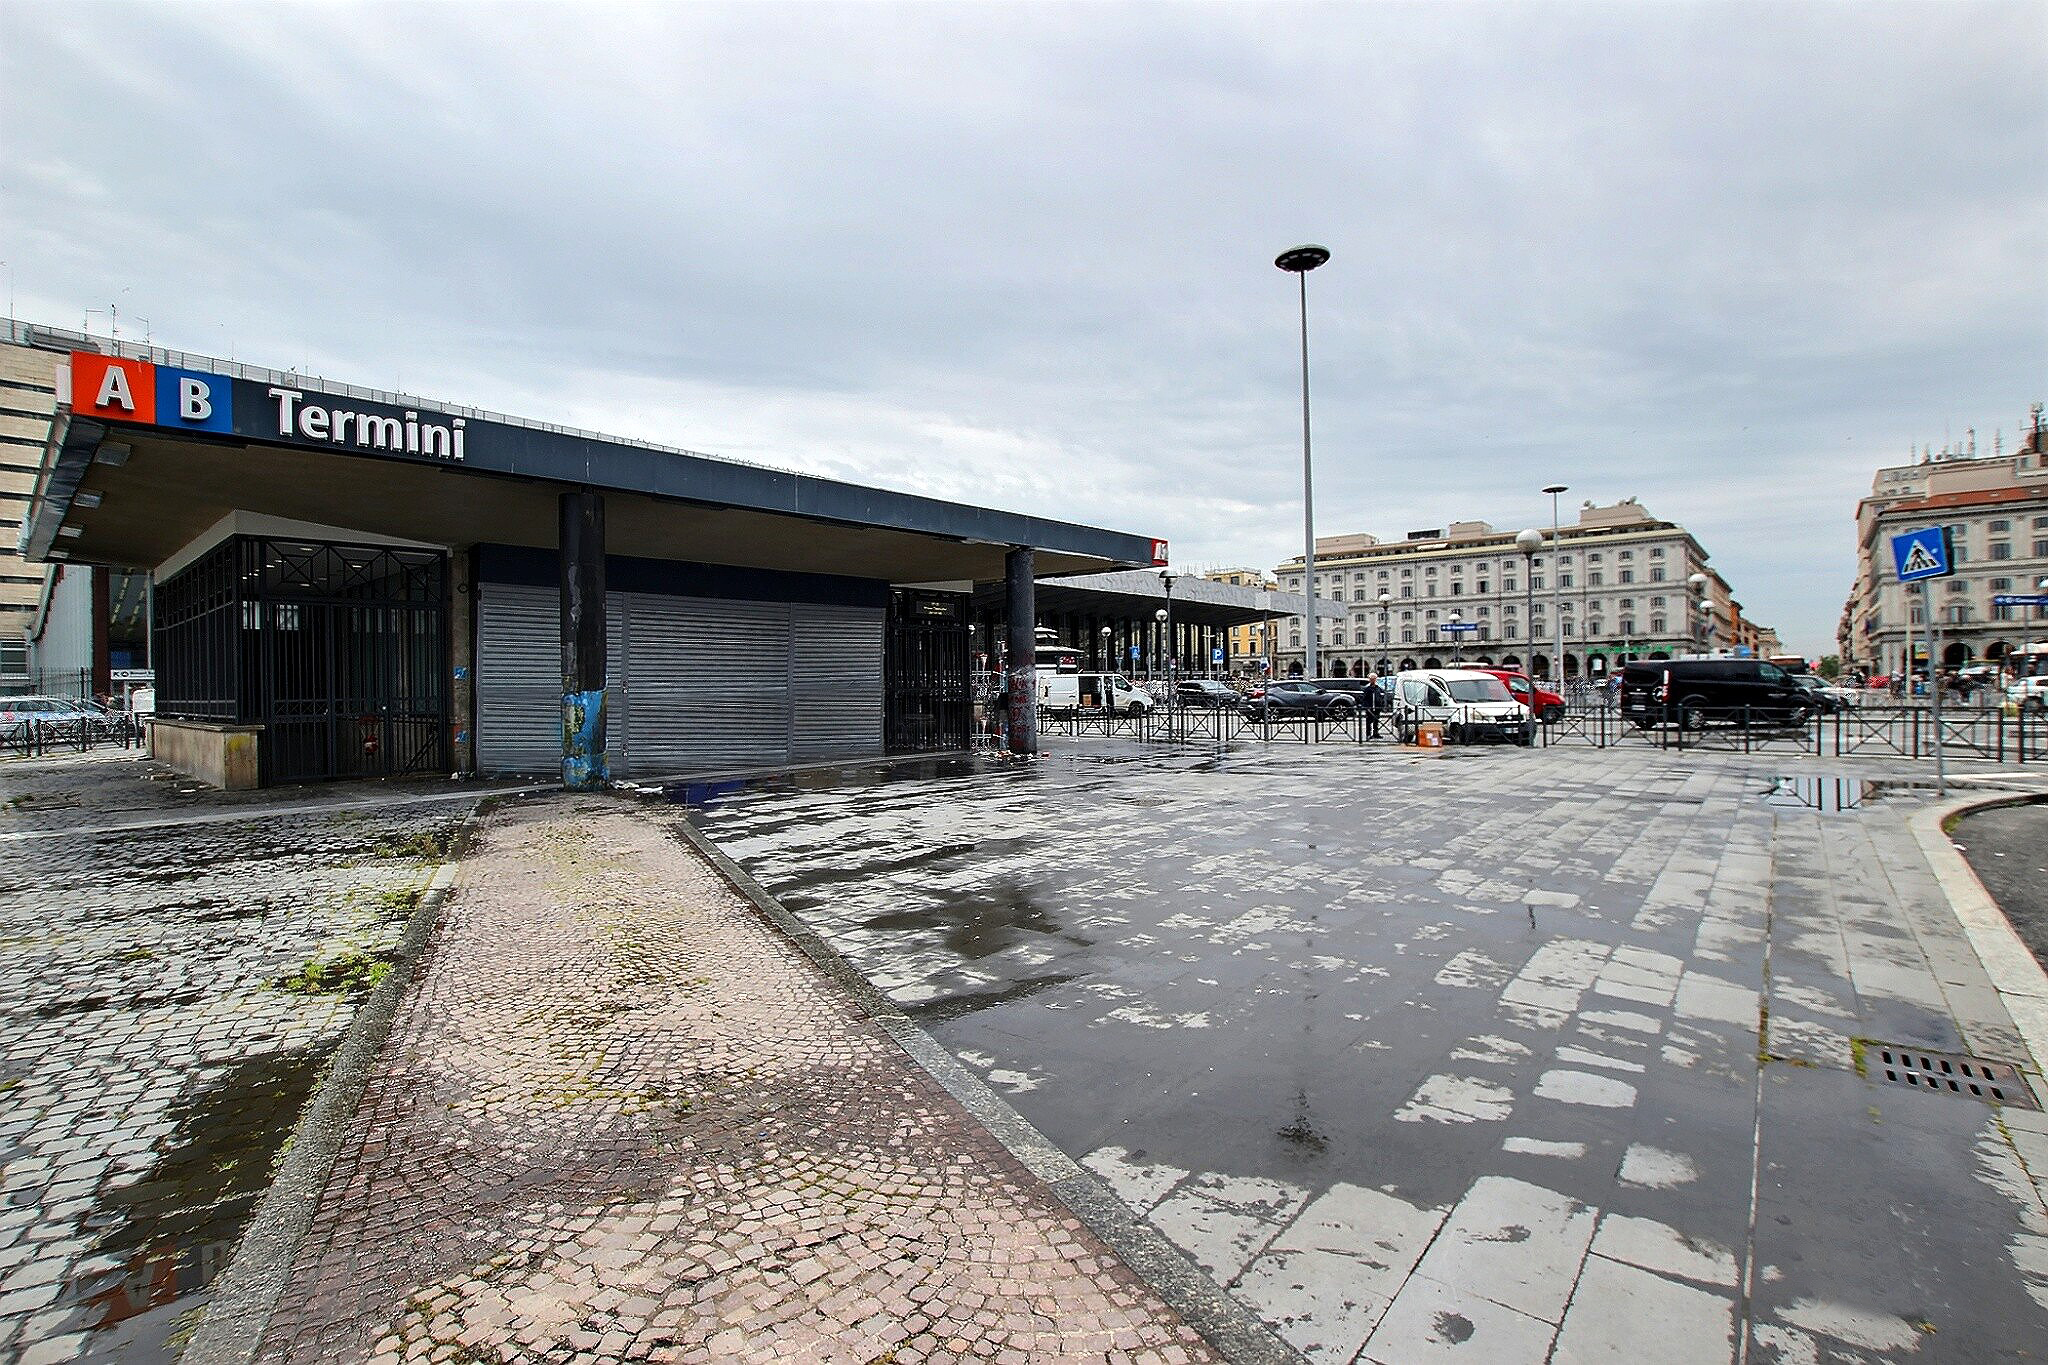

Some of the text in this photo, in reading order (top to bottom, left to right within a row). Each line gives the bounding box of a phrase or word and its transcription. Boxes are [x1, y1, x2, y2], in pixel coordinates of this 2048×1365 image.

[95, 365, 466, 460] A B Termini
